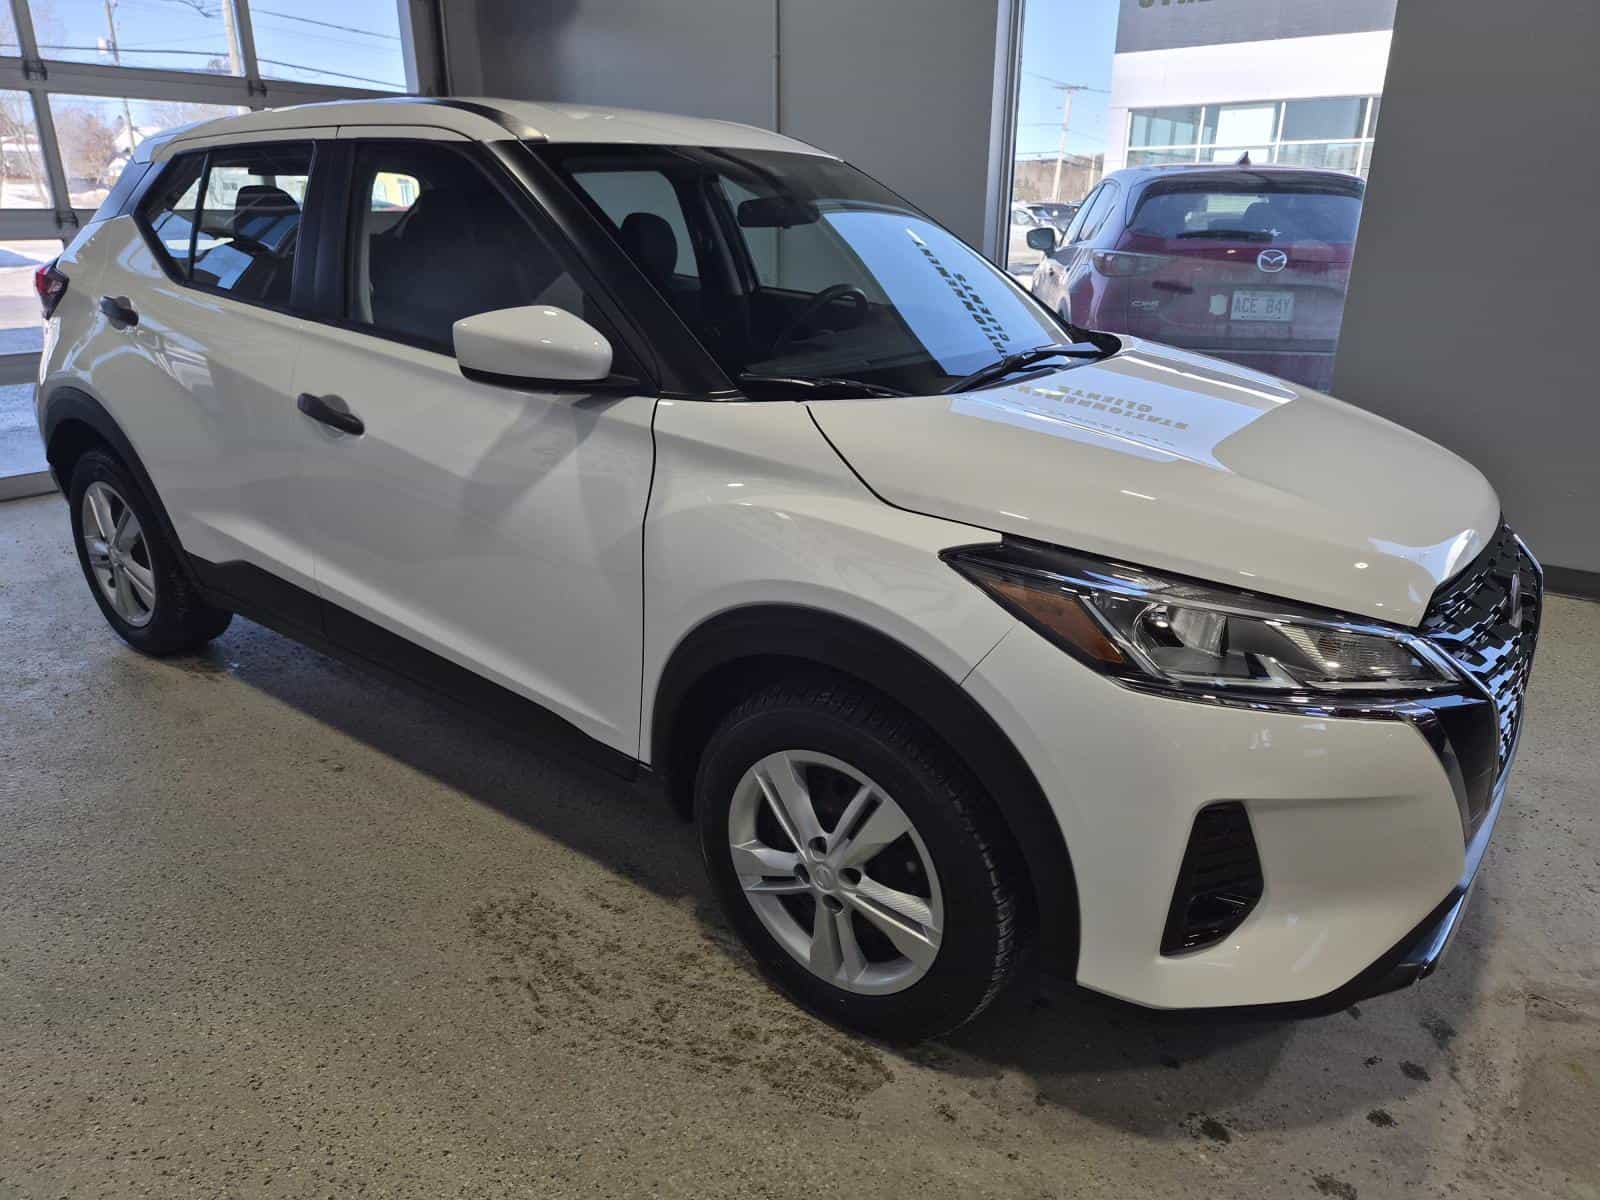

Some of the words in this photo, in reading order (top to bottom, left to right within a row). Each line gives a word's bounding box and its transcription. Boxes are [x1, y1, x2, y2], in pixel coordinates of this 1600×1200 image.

[953, 273, 1011, 342] CLIENTS
[1233, 297, 1259, 313] ACE
[1014, 384, 1190, 431] STATIONNEMEN
